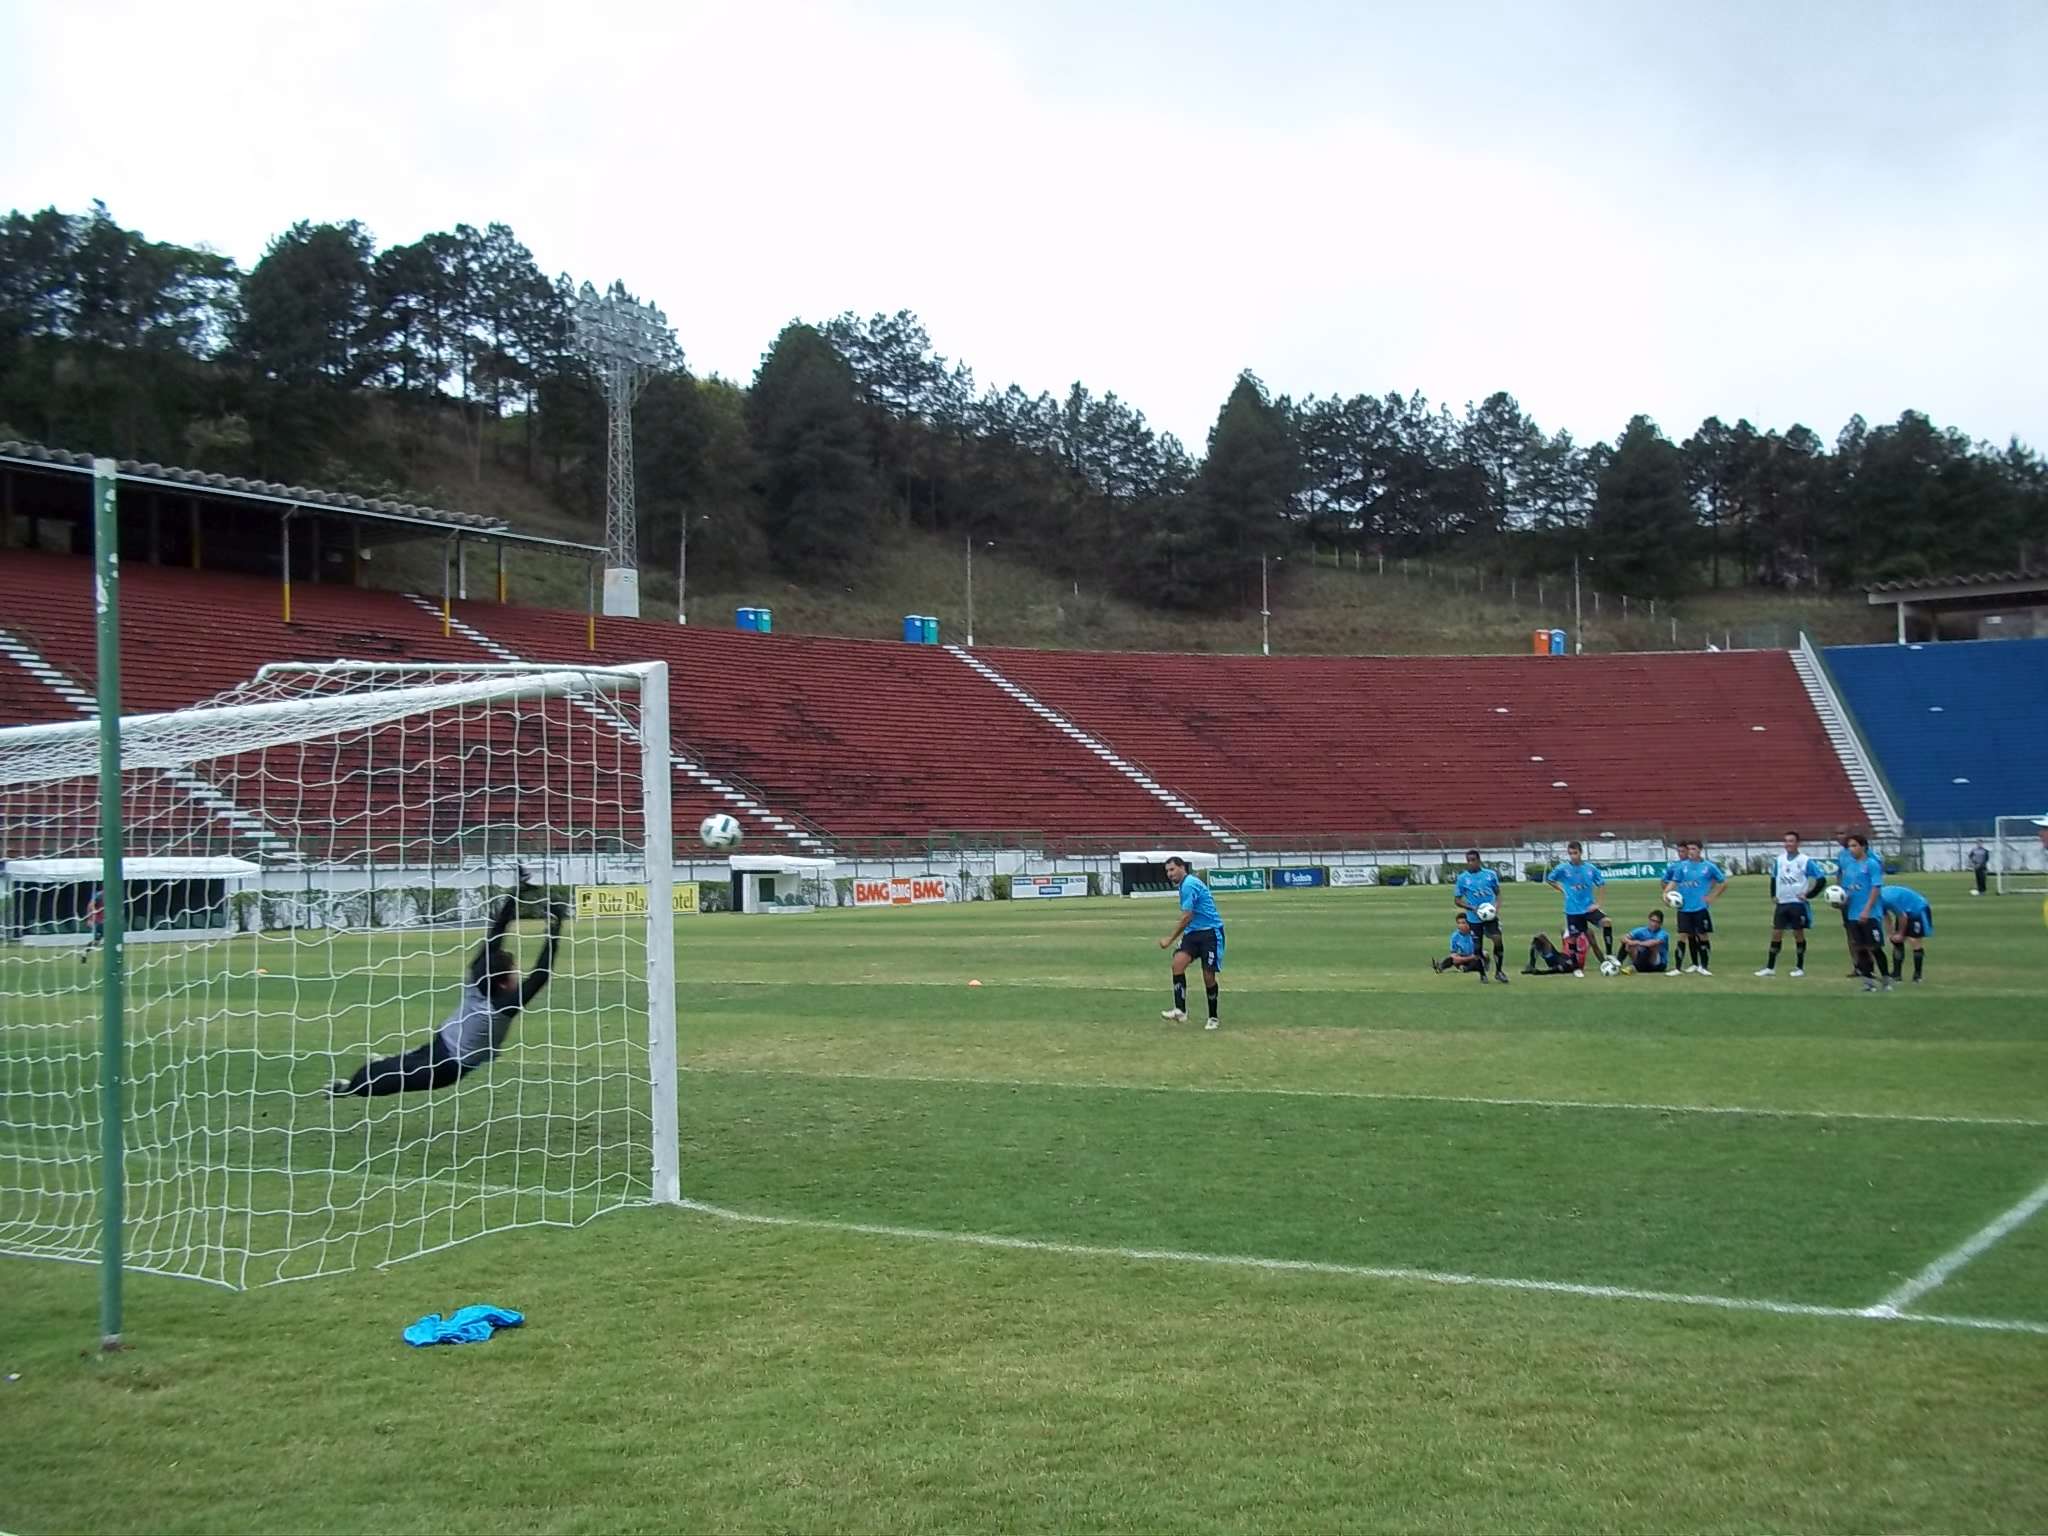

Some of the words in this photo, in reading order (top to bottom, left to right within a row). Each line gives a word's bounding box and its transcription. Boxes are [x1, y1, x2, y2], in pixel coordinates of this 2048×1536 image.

[1600, 864, 1637, 877] nimed
[598, 892, 623, 913] Ritz
[626, 890, 649, 912] Pla
[672, 888, 693, 909] otel
[856, 882, 890, 902] BMG
[913, 880, 945, 900] BMG
